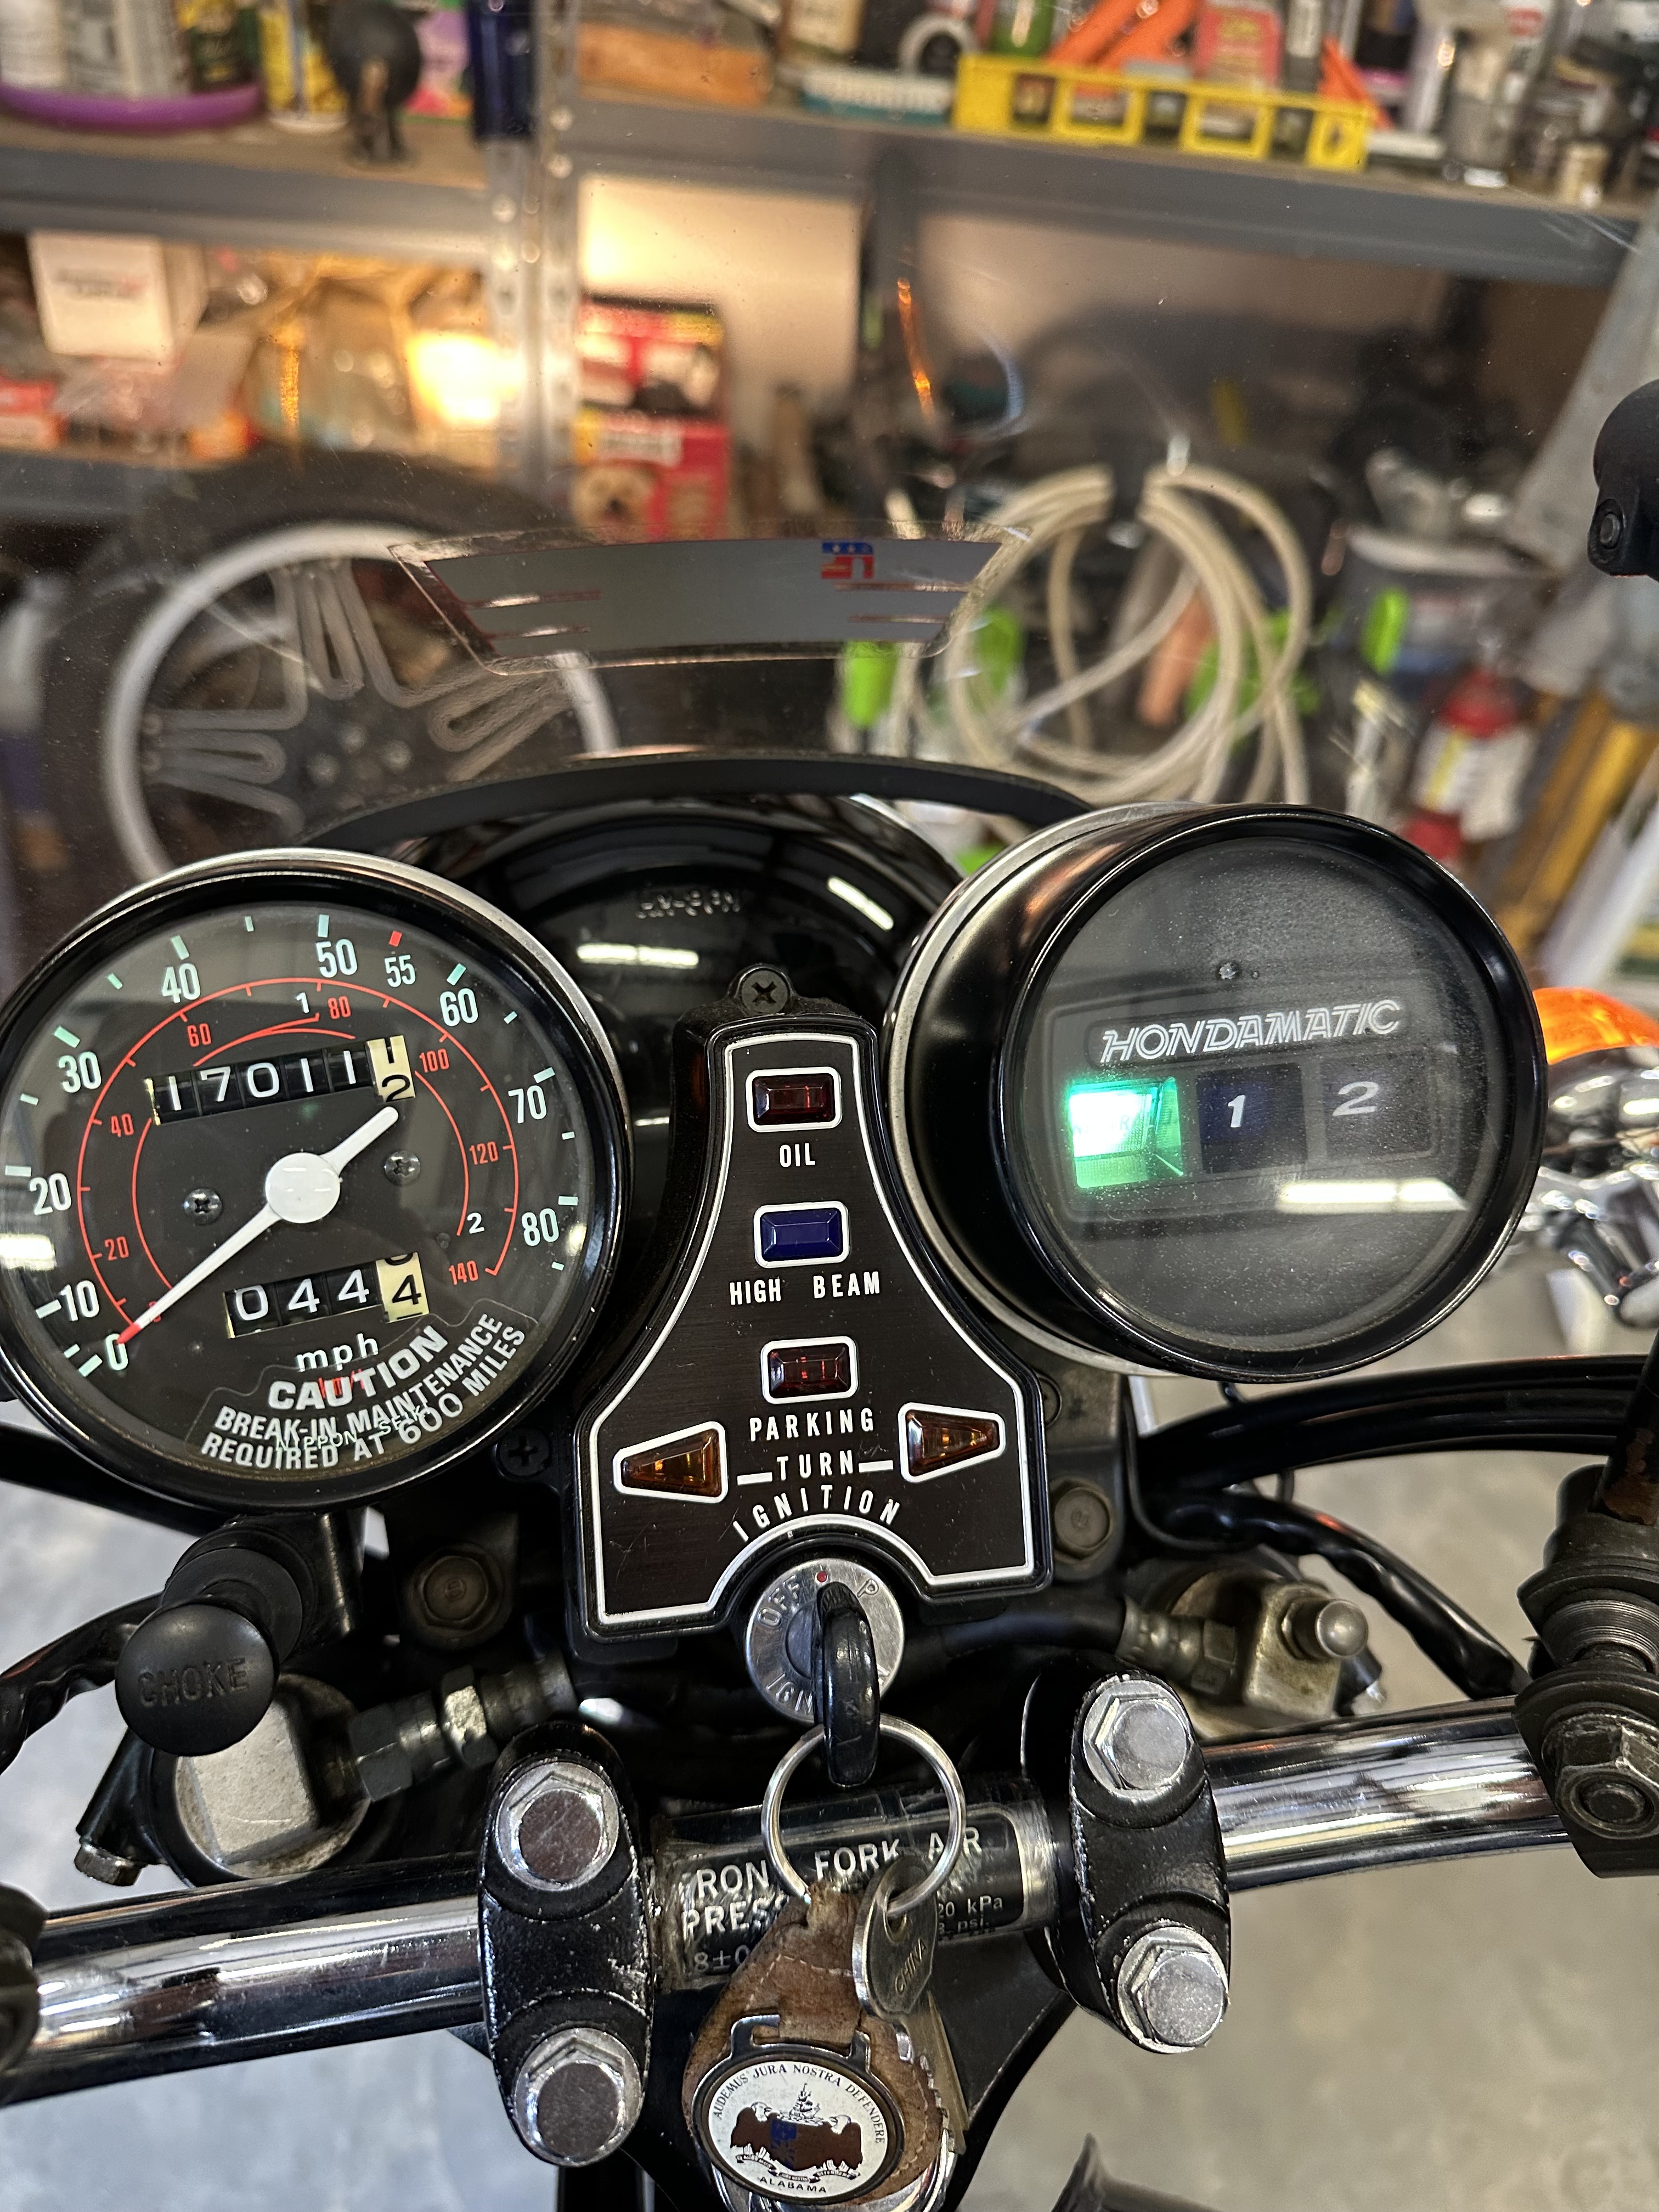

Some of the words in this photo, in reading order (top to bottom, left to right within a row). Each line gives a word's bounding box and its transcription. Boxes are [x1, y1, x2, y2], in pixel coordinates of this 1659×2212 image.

[316, 939, 358, 978] 50
[384, 955, 416, 988] 55
[162, 963, 201, 1003] 40
[296, 992, 309, 1013] 1
[328, 996, 351, 1019] 80
[440, 988, 478, 1026] 60
[188, 1023, 212, 1047] 60
[1101, 1000, 1400, 1063] HONDAMATIC
[59, 1051, 101, 1093] 30
[419, 1049, 450, 1073] 100
[508, 1085, 548, 1124] 70
[1227, 1095, 1245, 1128] 1
[1333, 1081, 1379, 1116] 2
[110, 1113, 134, 1137] 40
[470, 1141, 499, 1165] 120
[780, 1143, 816, 1167] OIL
[30, 1172, 71, 1215] 20
[467, 1212, 485, 1234] 2
[521, 1208, 560, 1247] 80
[105, 1237, 129, 1260] 20
[449, 1261, 479, 1285] 140
[730, 1279, 781, 1305] HIGH
[813, 1272, 880, 1299] BEAM
[60, 1280, 99, 1321] 10
[106, 1334, 128, 1370] 0
[269, 1325, 448, 1409] CAUTION
[296, 1333, 379, 1370] mph
[215, 1406, 338, 1441] BREAK-IN
[347, 1314, 503, 1434] MAINTENANCE
[201, 1432, 338, 1470] REQUIRED
[354, 1431, 387, 1462] AT
[399, 1393, 463, 1444] 600
[462, 1325, 527, 1397] MILES
[749, 1408, 874, 1441] PARKING
[777, 1450, 854, 1479] TURN
[732, 1483, 900, 1541] IGNITION
[758, 1575, 799, 1626] OFF
[856, 1578, 879, 1598] P
[138, 1657, 249, 1707] CHOKE
[815, 1839, 900, 1881] FORK
[928, 1827, 982, 1860] AR
[967, 1895, 1003, 1914] kPa
[713, 2074, 749, 2120] AUDEMUS
[753, 2064, 787, 2079] JURA
[793, 2064, 840, 2086] NOSTRA
[844, 2083, 886, 2144] DEFENDERE
[760, 2176, 827, 2193] ALABAMA
